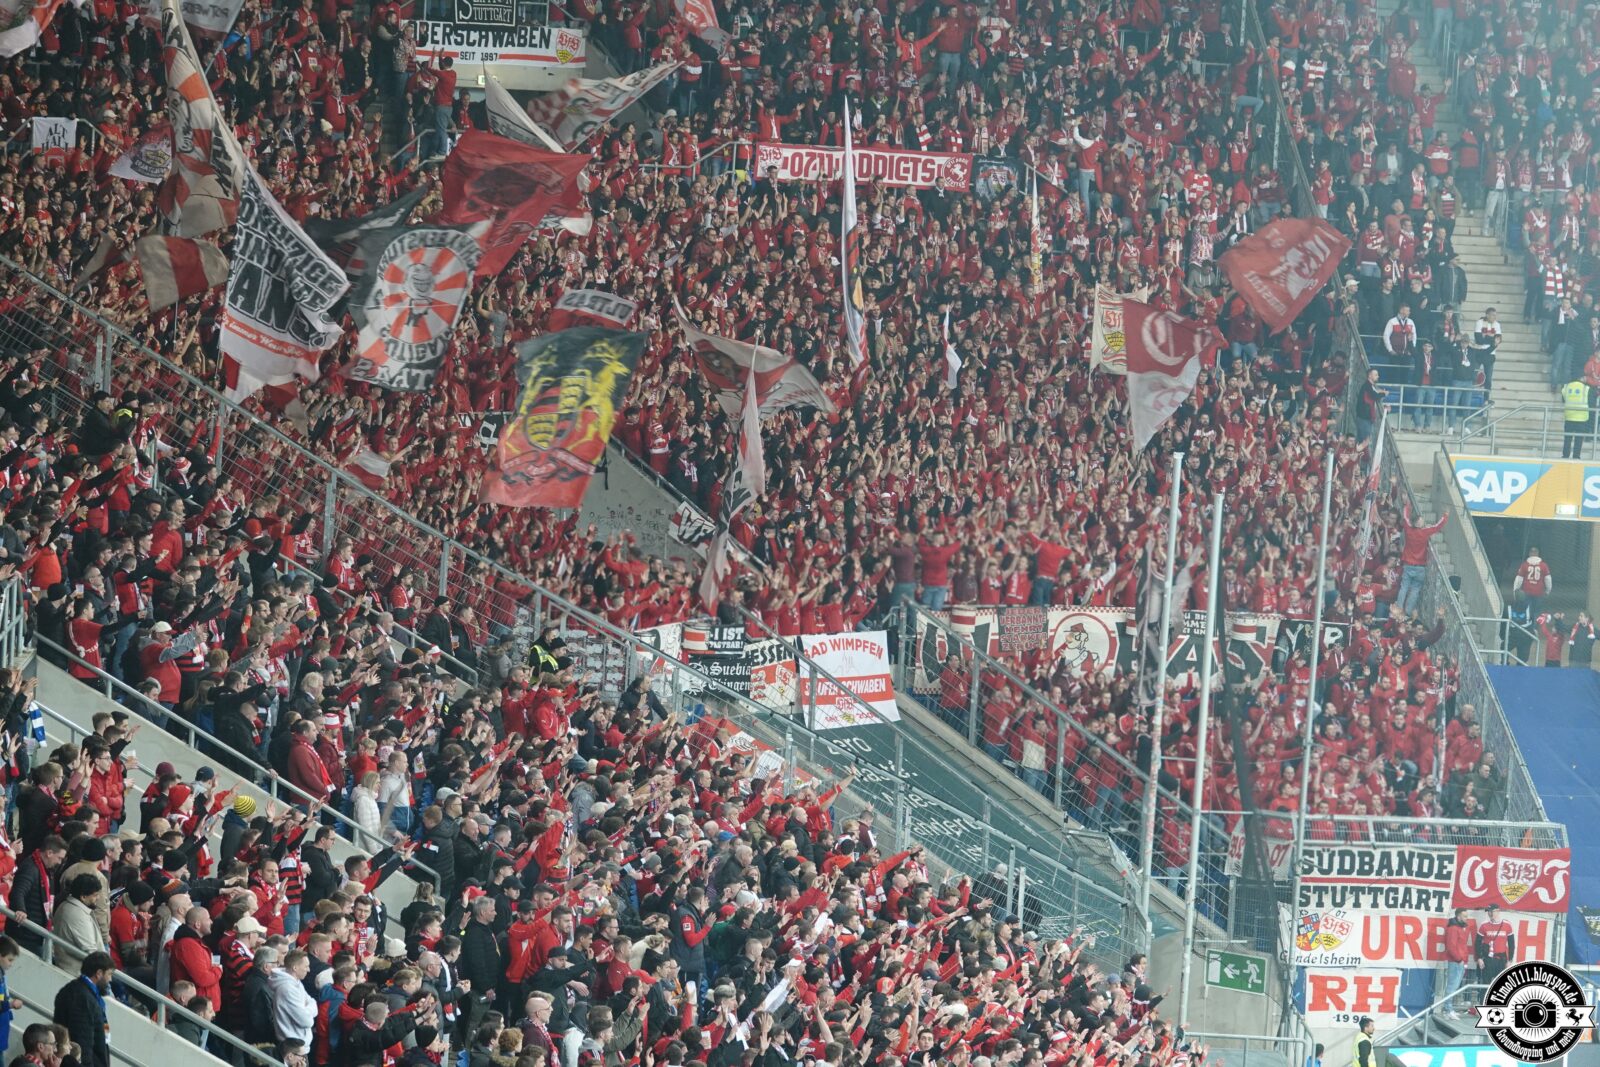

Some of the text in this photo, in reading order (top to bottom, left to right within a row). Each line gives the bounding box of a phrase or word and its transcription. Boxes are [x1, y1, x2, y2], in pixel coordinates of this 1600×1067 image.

[460, 51, 476, 61] SEIT
[789, 151, 834, 180] 0711
[842, 152, 937, 183] DDICTS
[1456, 468, 1528, 504] SAP
[1527, 565, 1541, 581] 26
[723, 627, 745, 641] IST
[829, 637, 884, 661] WIMPFEN
[804, 681, 841, 697] SUFER
[1301, 847, 1455, 881] SÜDBANDE
[1300, 885, 1450, 913] STUTTGART
[1279, 949, 1361, 966] Gndelsheim
[1308, 974, 1399, 1014] RH
